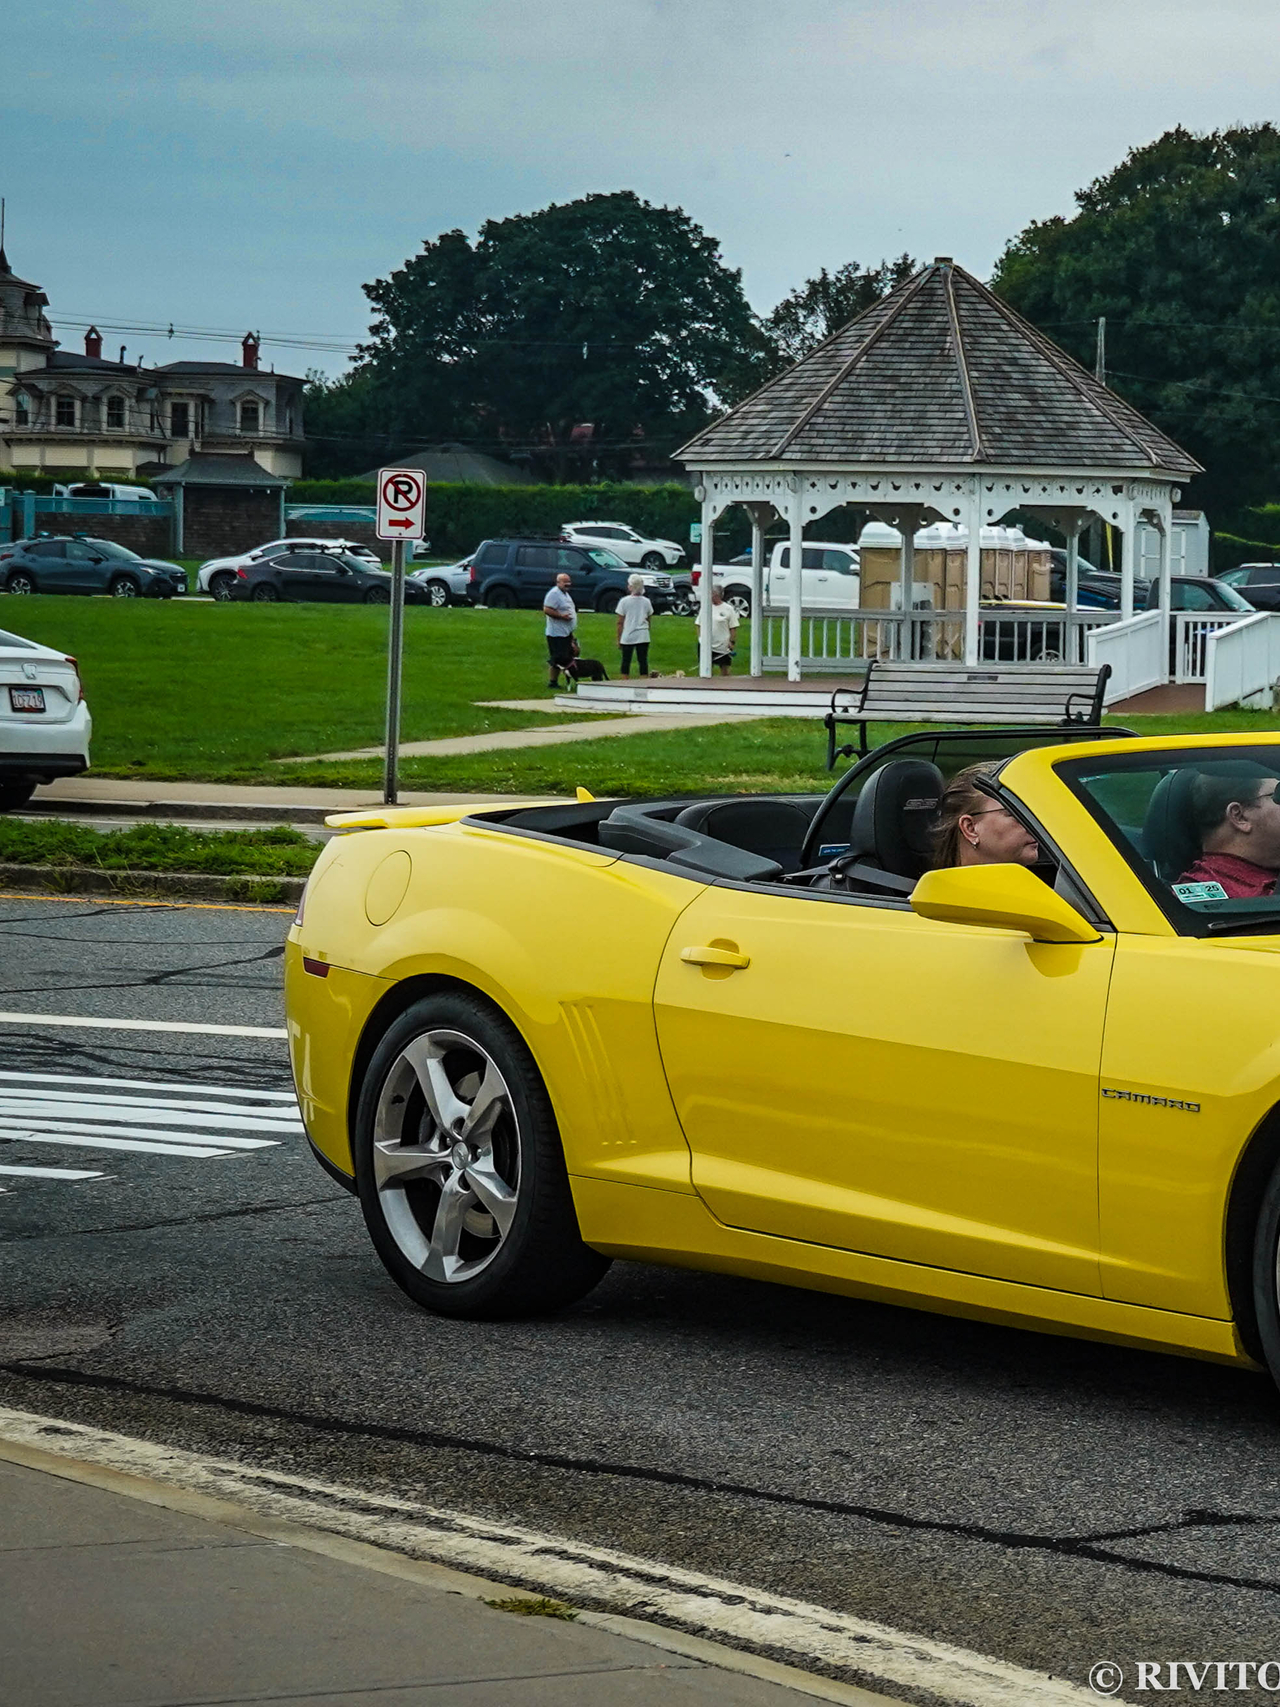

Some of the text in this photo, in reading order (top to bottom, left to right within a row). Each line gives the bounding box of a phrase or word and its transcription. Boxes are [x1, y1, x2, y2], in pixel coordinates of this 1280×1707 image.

[393, 479, 413, 504] P
[1178, 887, 1193, 895] 01
[1101, 1088, 1200, 1112] CAMARO
